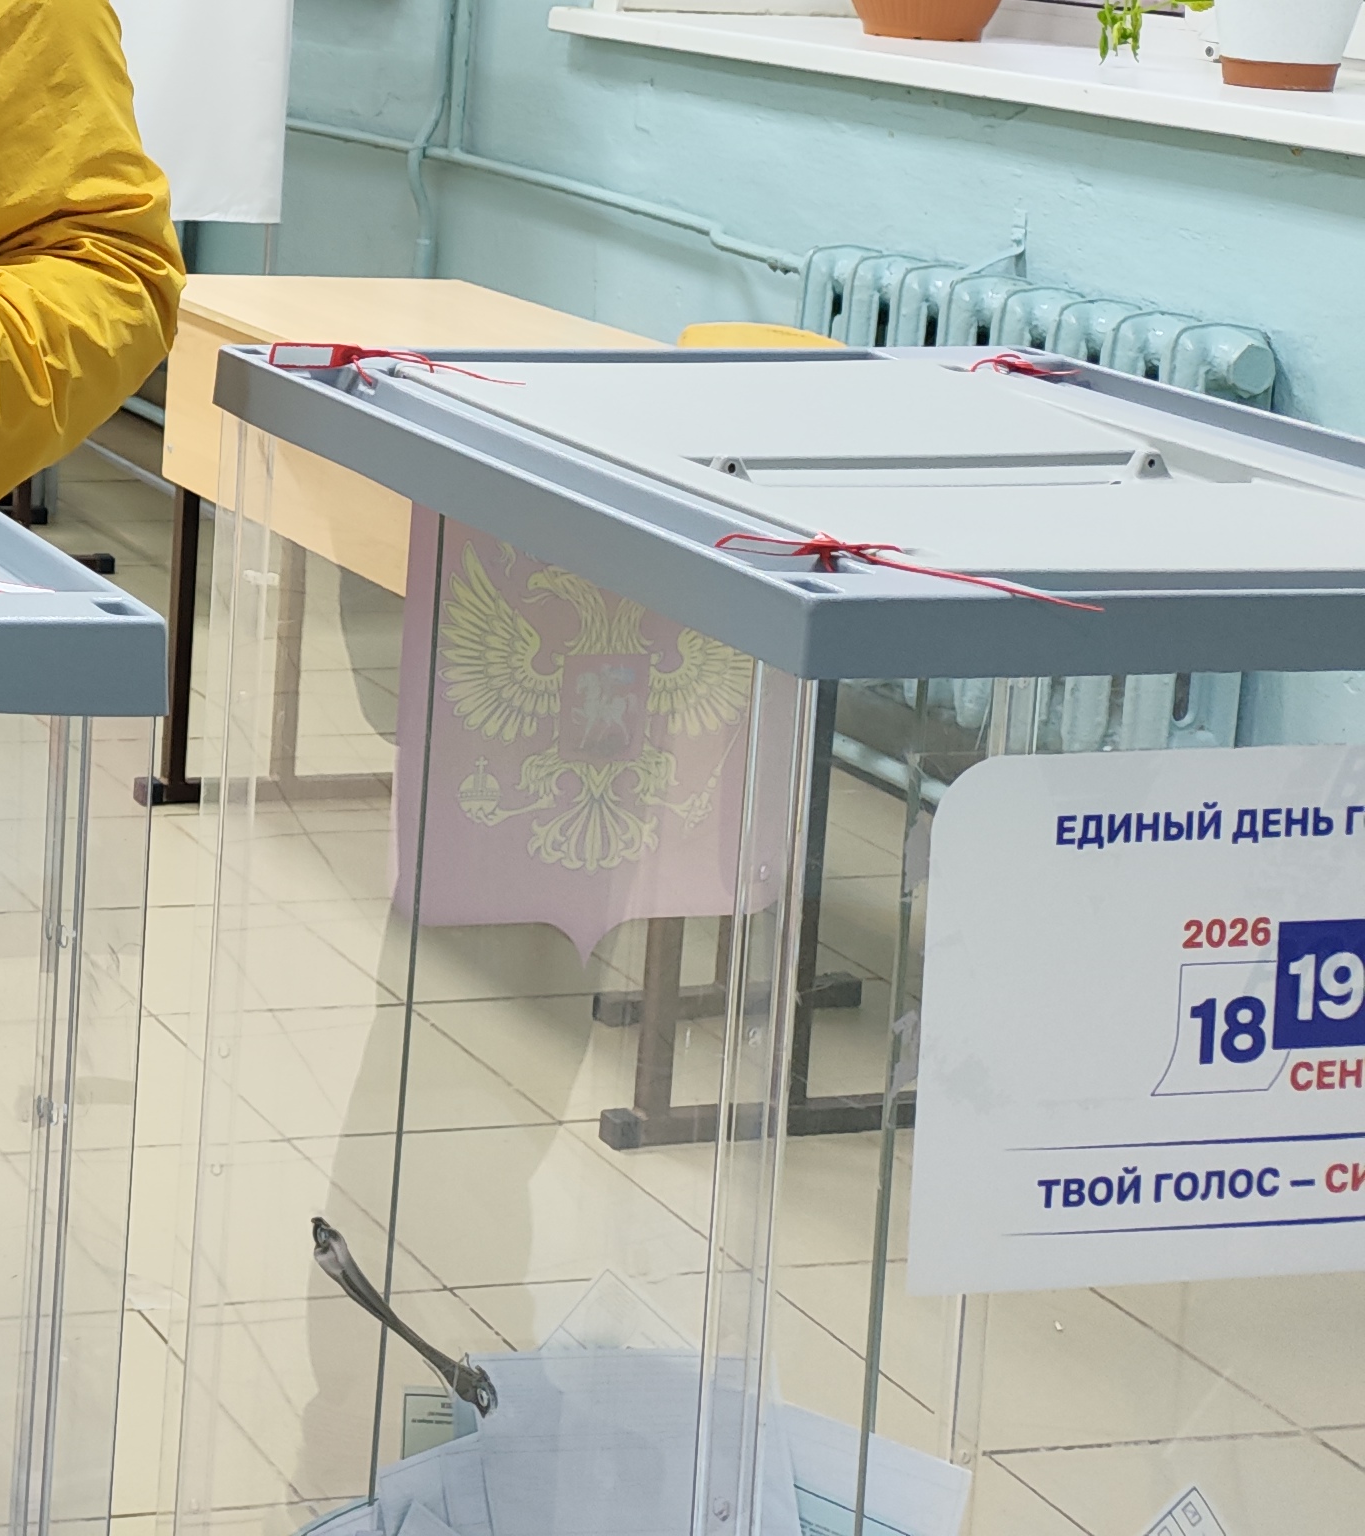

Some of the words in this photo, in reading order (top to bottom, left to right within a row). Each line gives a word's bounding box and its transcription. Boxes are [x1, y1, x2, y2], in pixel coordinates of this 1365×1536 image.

[1055, 801, 1223, 851] ЕДИНЫЙ
[1232, 806, 1334, 845] ДЕНЬ
[1345, 805, 1365, 835] Г
[1182, 916, 1272, 949] 2026
[1288, 951, 1365, 1021] 19
[1189, 996, 1267, 1065] 18
[1037, 1166, 1142, 1209] ТВОЙ
[1154, 1167, 1280, 1204] ГОЛОС
